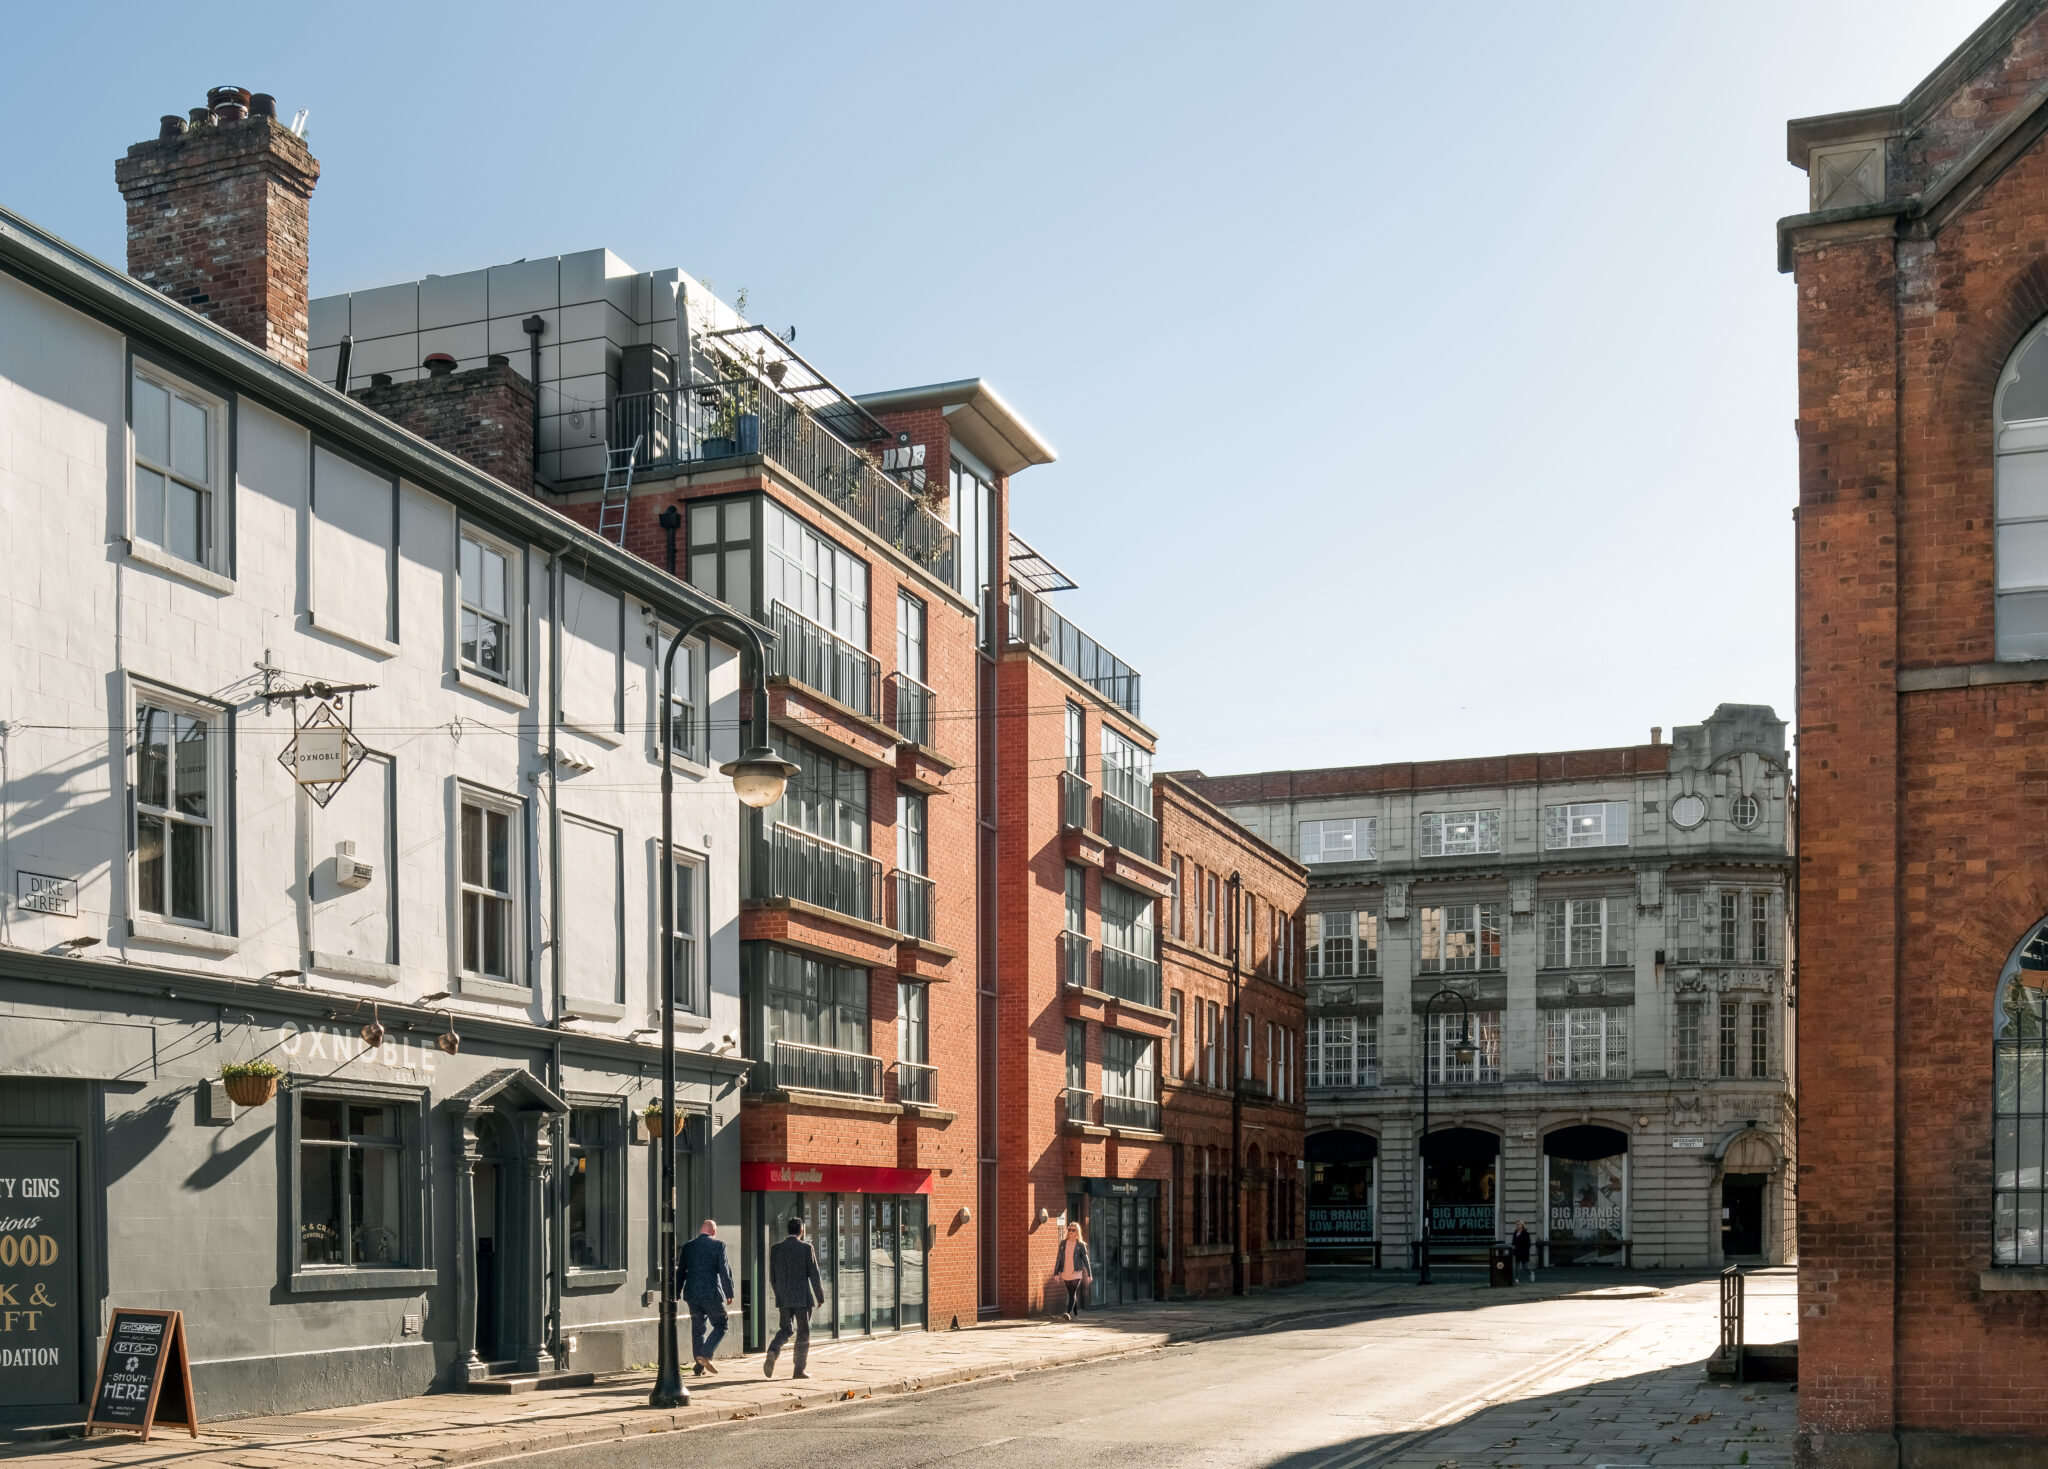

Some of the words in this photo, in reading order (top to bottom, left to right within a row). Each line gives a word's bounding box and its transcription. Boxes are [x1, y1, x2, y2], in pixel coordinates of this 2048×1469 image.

[299, 753, 341, 762] OXNOBLE
[31, 877, 63, 896] DUKE
[25, 894, 69, 913] STREET
[278, 1021, 435, 1071] OXNOBLE
[22, 1178, 60, 1198] GINS
[1309, 1209, 1327, 1220] BIG
[1433, 1207, 1451, 1218] BIG
[1551, 1207, 1571, 1218] BIG
[1574, 1206, 1620, 1218] BRANDS
[1309, 1221, 1332, 1231] LOW
[1336, 1220, 1373, 1231] PRICES
[1433, 1218, 1456, 1229] LOW
[1551, 1218, 1576, 1230] LOW
[1580, 1218, 1620, 1230] PRICES
[29, 1282, 57, 1307] &
[119, 1344, 133, 1353] BT
[112, 1373, 147, 1383] SHOWN
[103, 1382, 149, 1400] HERE
